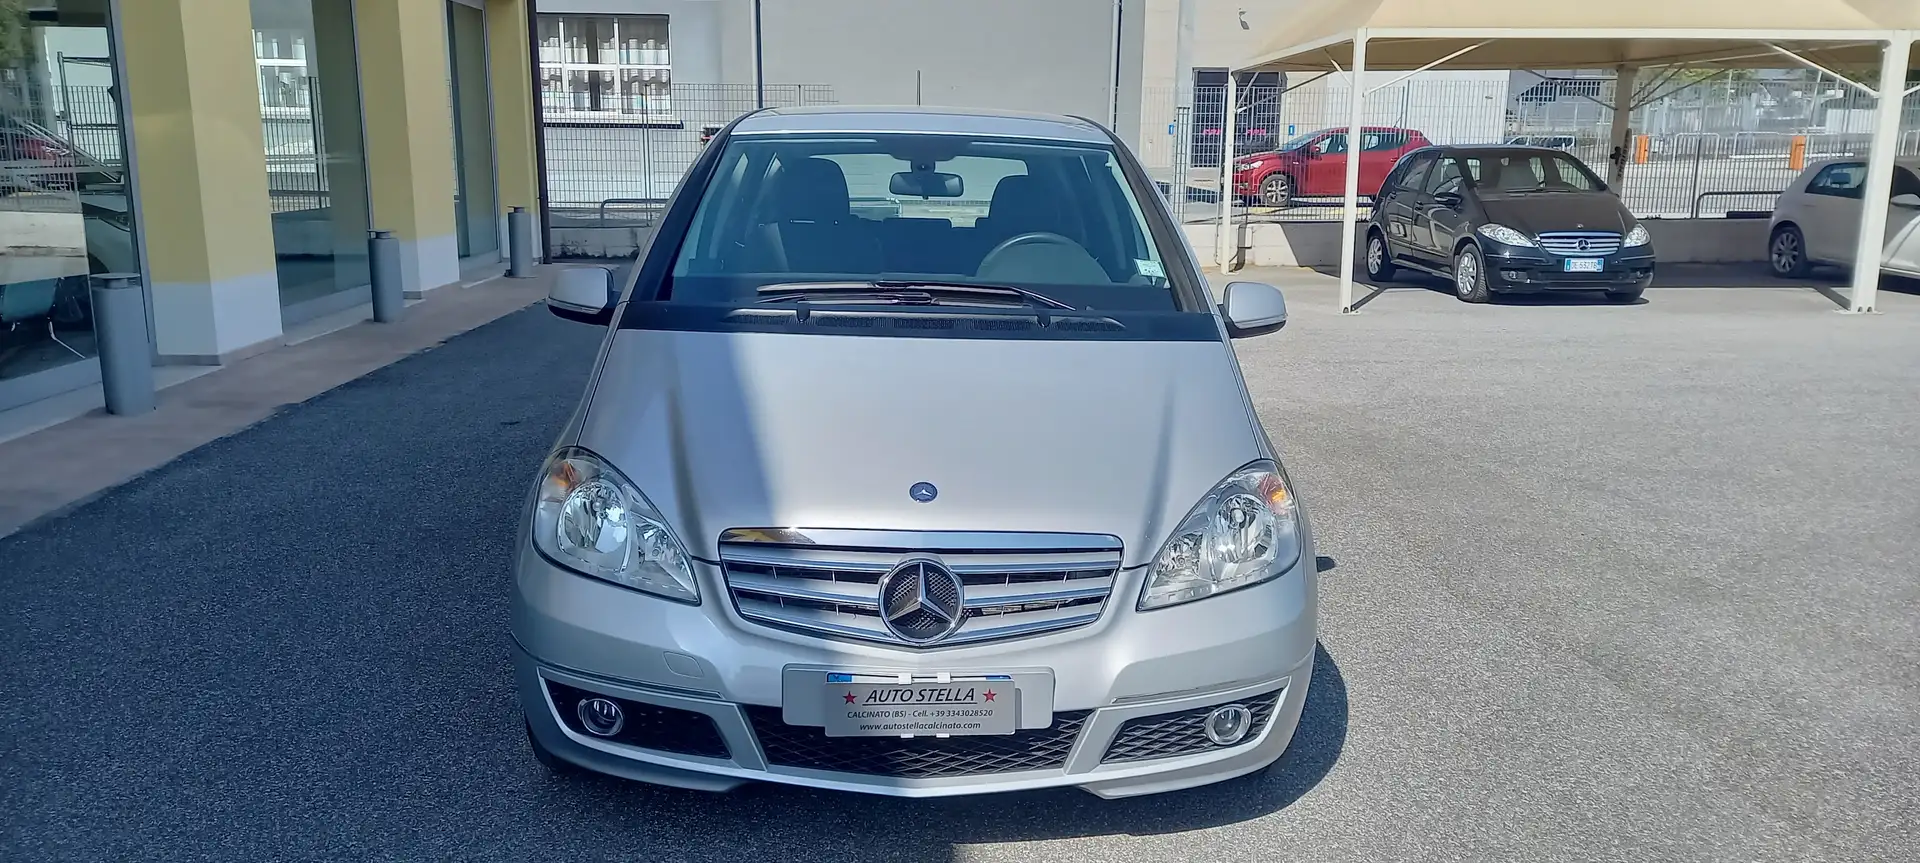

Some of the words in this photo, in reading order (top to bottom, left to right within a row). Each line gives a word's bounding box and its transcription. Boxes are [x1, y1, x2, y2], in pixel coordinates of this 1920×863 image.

[865, 688, 914, 703] AUTO
[915, 687, 975, 702] STELLA
[847, 710, 890, 719] CALCINATO
[891, 710, 907, 718] (BS)
[912, 710, 929, 718] Cell.
[946, 709, 993, 717] 3343028520
[859, 721, 981, 731] www.autostellacalcinato.com
